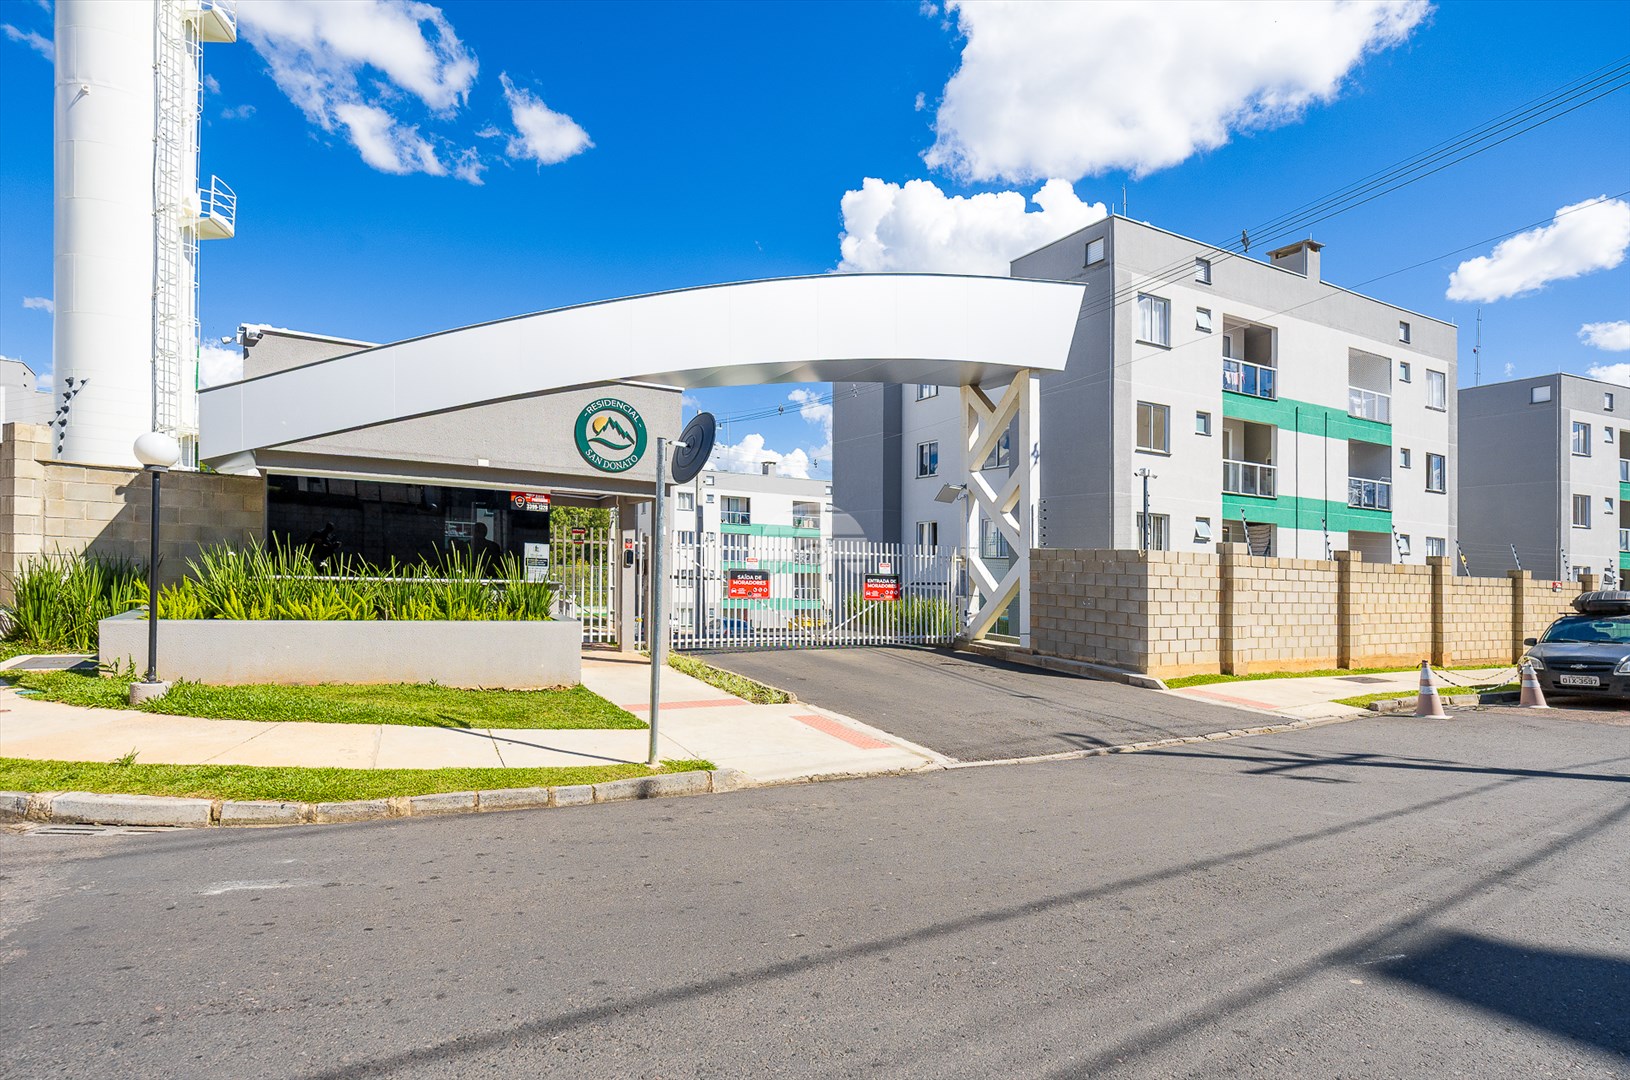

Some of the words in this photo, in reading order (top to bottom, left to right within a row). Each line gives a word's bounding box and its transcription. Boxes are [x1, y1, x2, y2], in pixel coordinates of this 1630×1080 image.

[586, 400, 640, 423] RESIDENCIAL
[585, 449, 603, 465] SAN
[602, 454, 639, 470] DONATO
